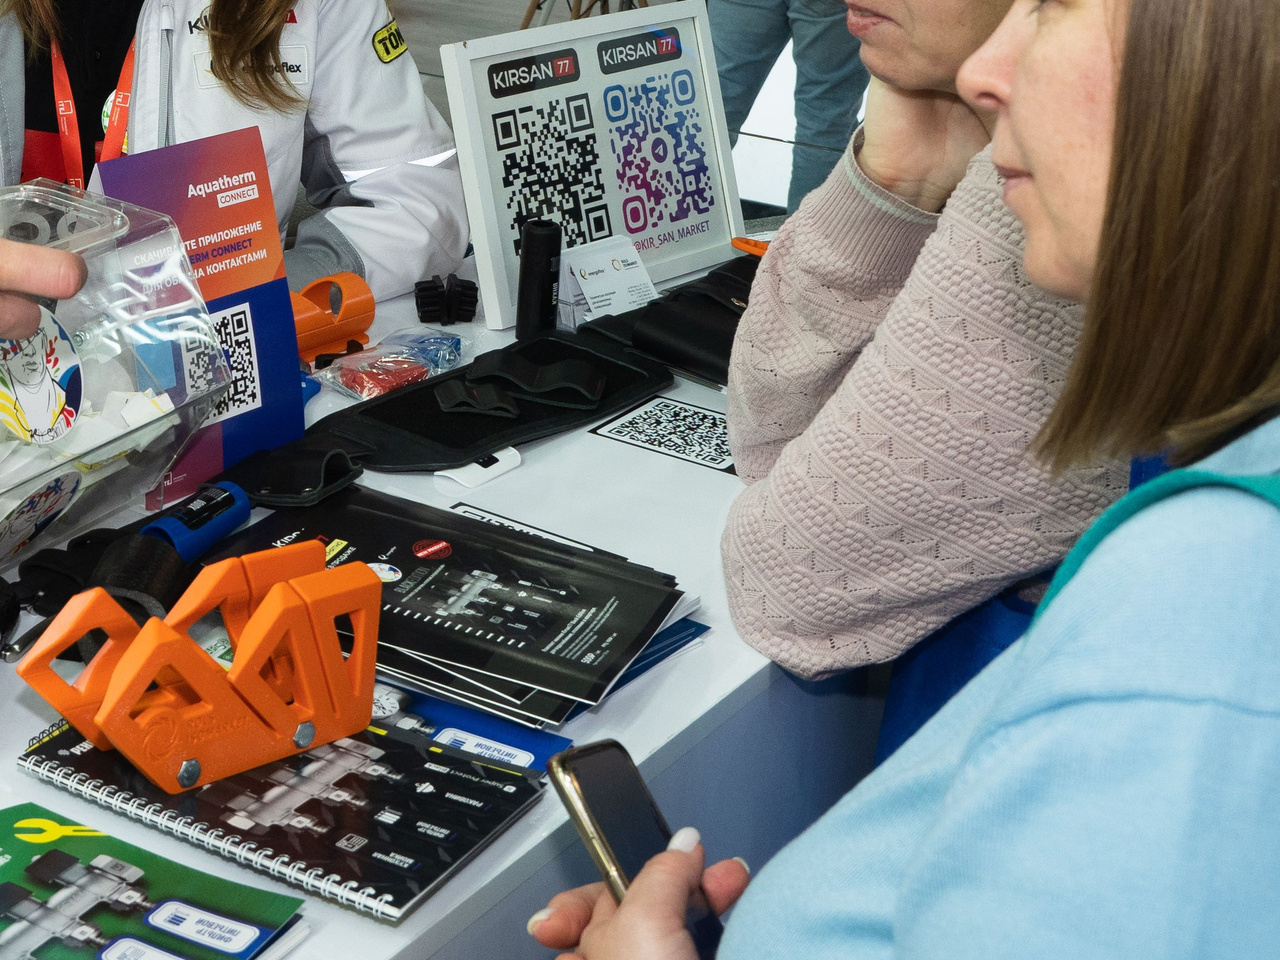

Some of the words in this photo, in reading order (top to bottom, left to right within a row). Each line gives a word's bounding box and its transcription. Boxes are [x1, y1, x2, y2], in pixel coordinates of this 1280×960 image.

[602, 39, 658, 66] KIRSAN
[660, 38, 673, 52] 77
[493, 62, 554, 90] KIRSAN
[557, 60, 570, 74] 77
[187, 171, 256, 198] Aquatherm
[219, 187, 256, 205] CONNECT
[198, 220, 262, 247] ПРИЛОЖЕНИЕ
[211, 238, 253, 259] CONNECT
[206, 248, 268, 275] КОНТАКТАМИ
[474, 742, 518, 759] ПИТЬЕВОЙ
[451, 770, 480, 783] Protect
[481, 777, 505, 790] Super
[445, 792, 484, 807] РАКОВИНА
[372, 851, 410, 868] КУХОННАЯ
[195, 917, 240, 937] ПИТЬЕВОЙ
[195, 928, 233, 943] ФИЛЬТР
